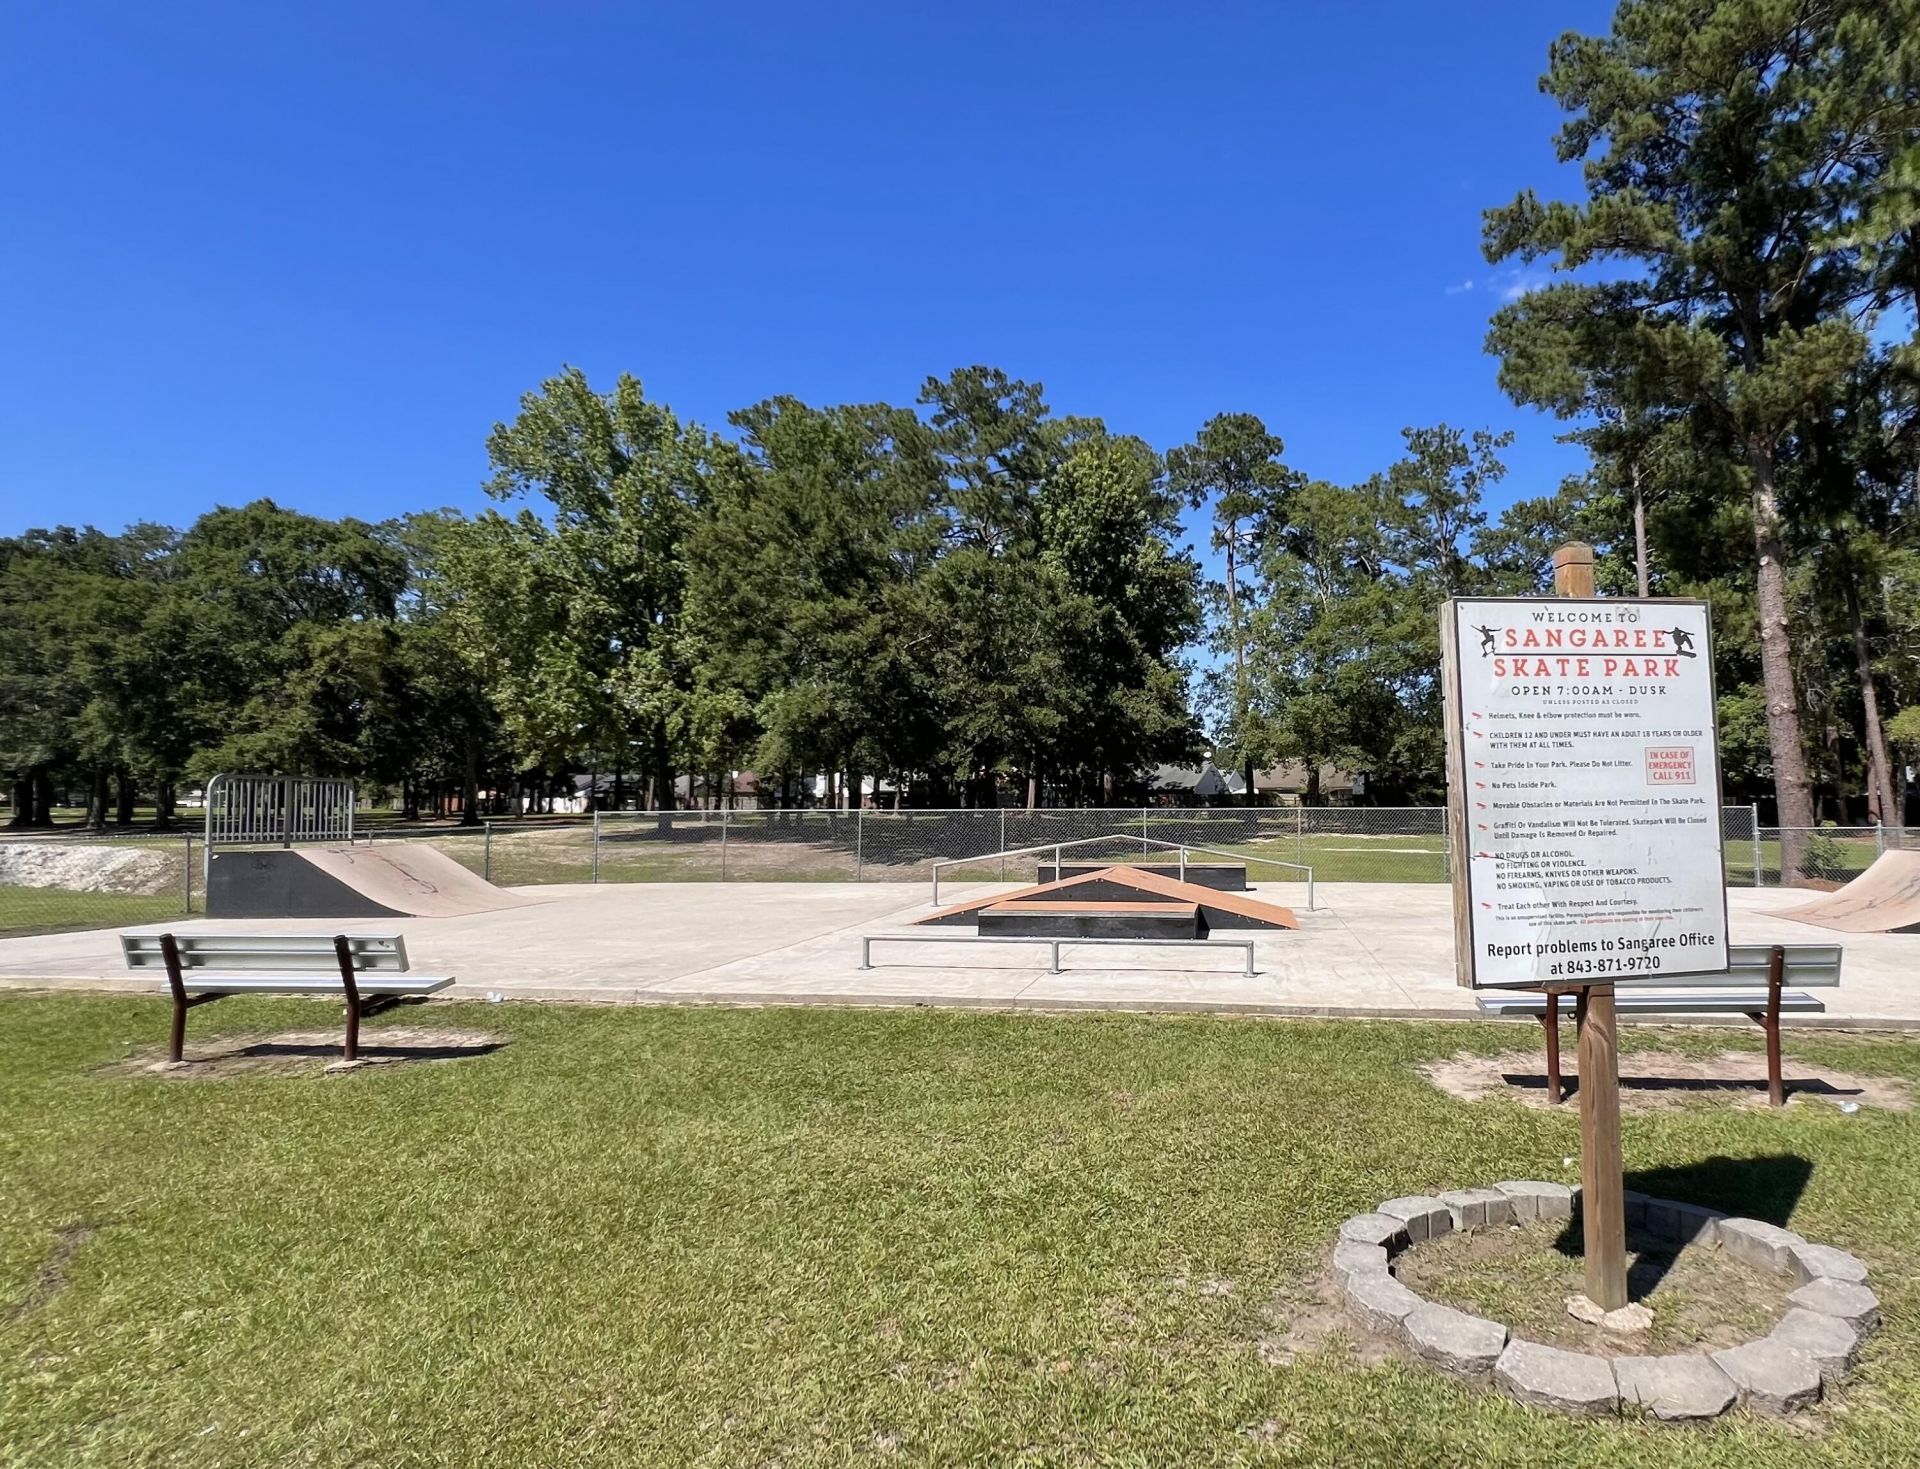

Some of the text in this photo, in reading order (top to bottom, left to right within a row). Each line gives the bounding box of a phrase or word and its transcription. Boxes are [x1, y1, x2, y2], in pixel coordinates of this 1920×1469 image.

[1532, 612, 1638, 623] WELCOME TO
[1505, 629, 1666, 648] SANGAREE
[1494, 658, 1680, 677] SKATE PARK
[1511, 686, 1551, 695] OPEN
[1557, 686, 1613, 695] 7:00AM
[1629, 686, 1667, 695] DUSK
[1569, 901, 1594, 909] Respect
[1488, 933, 1715, 959] Report problems to Sangaree Office
[1550, 956, 1660, 975] at 843-871-9720
